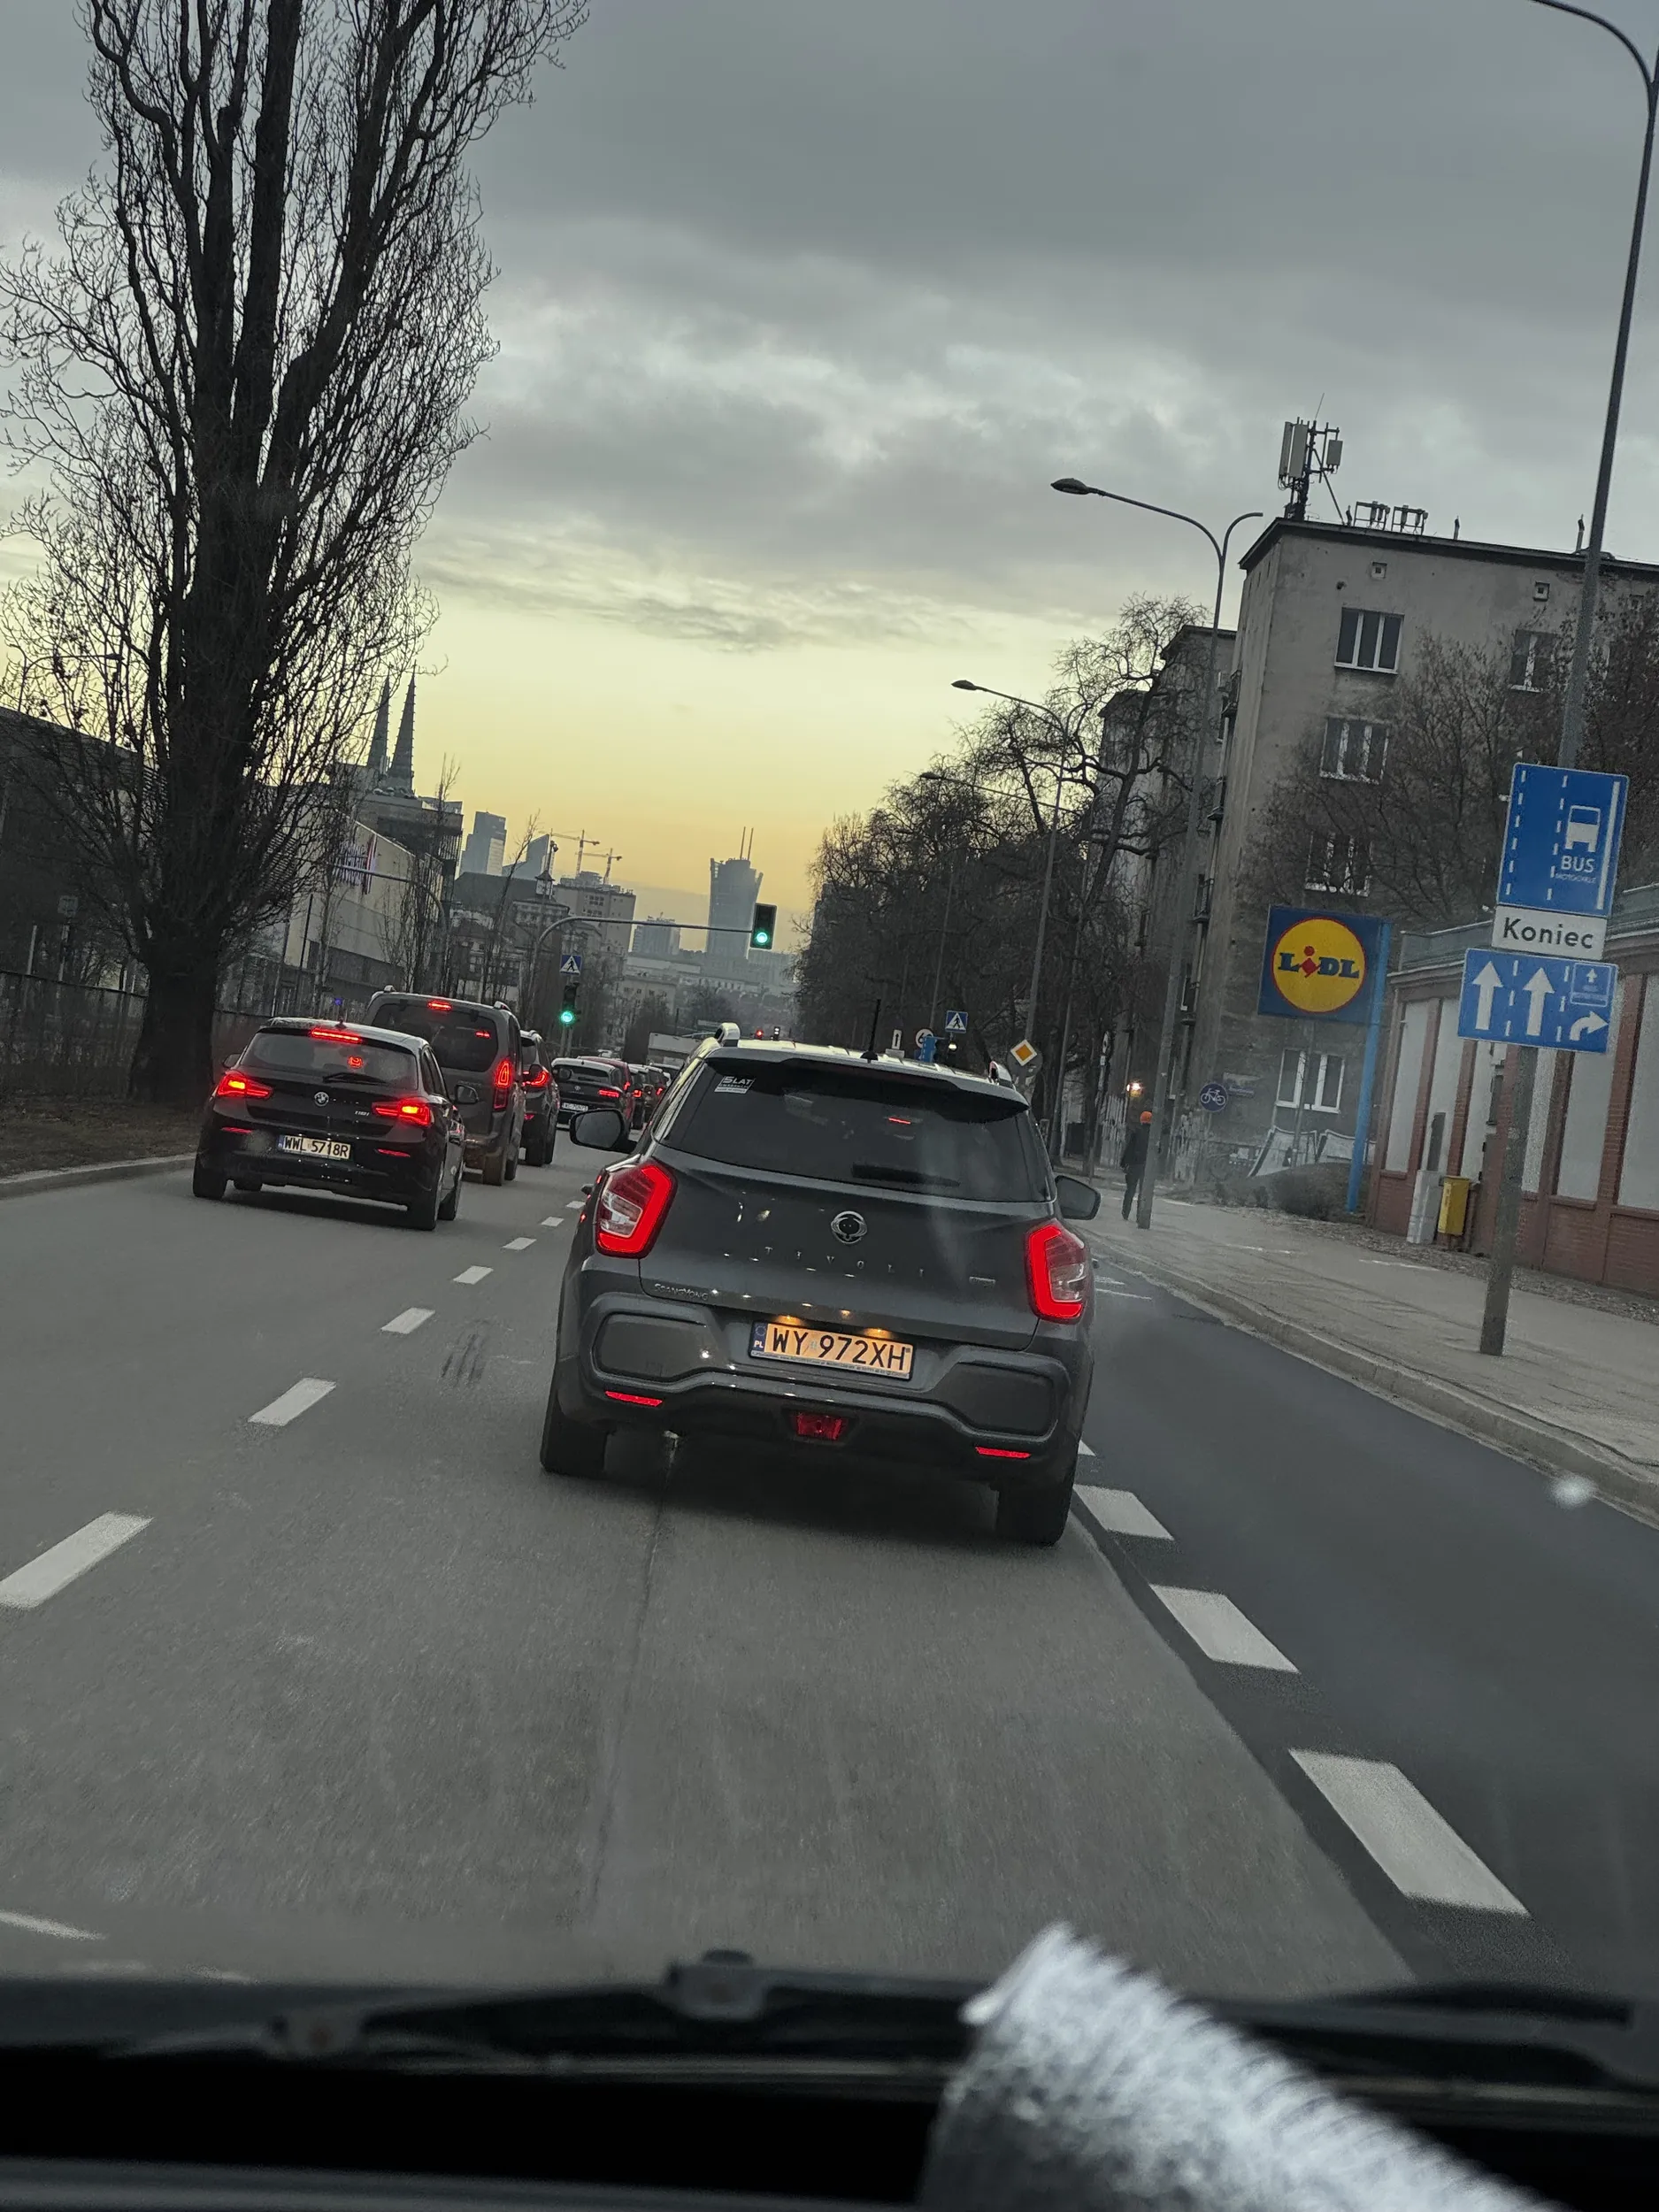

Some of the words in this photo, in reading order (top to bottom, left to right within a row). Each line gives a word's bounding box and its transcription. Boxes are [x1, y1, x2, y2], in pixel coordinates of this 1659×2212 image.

[1561, 855, 1595, 873] BUS
[1503, 917, 1594, 949] Koniec
[284, 1137, 306, 1151] WWL
[311, 1141, 349, 1157] 5718R
[764, 1246, 925, 1278] TIVOLI
[772, 1327, 809, 1356] WY
[818, 1334, 906, 1371] 972XH
